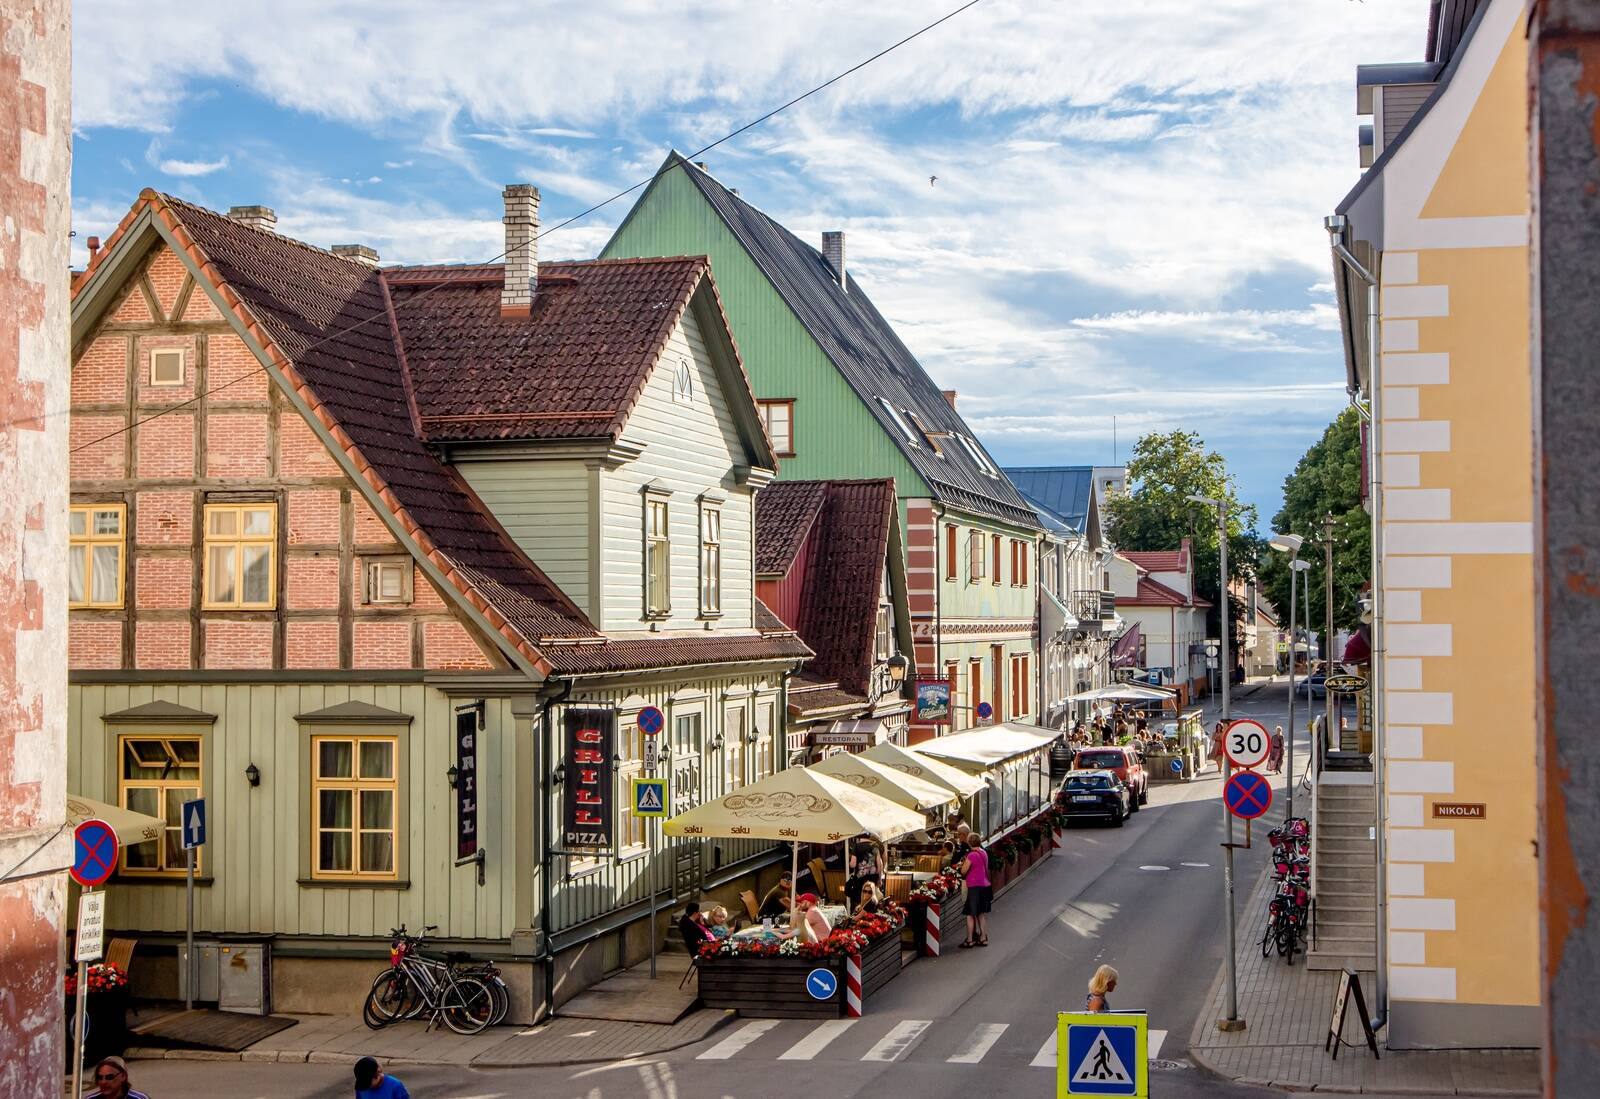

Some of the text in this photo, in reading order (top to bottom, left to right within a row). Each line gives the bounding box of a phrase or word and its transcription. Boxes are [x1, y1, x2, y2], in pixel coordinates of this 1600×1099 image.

[1232, 733, 1262, 755] 30
[646, 753, 655, 762] 30
[575, 728, 603, 825] GRILL
[462, 734, 475, 834] GRILL
[1439, 806, 1480, 816] NIKOLAI
[142, 827, 158, 840] saku
[684, 826, 704, 834] saku
[731, 826, 750, 834] saku
[779, 828, 799, 837] saku
[566, 832, 608, 845] PIZZA
[827, 832, 841, 841] sak
